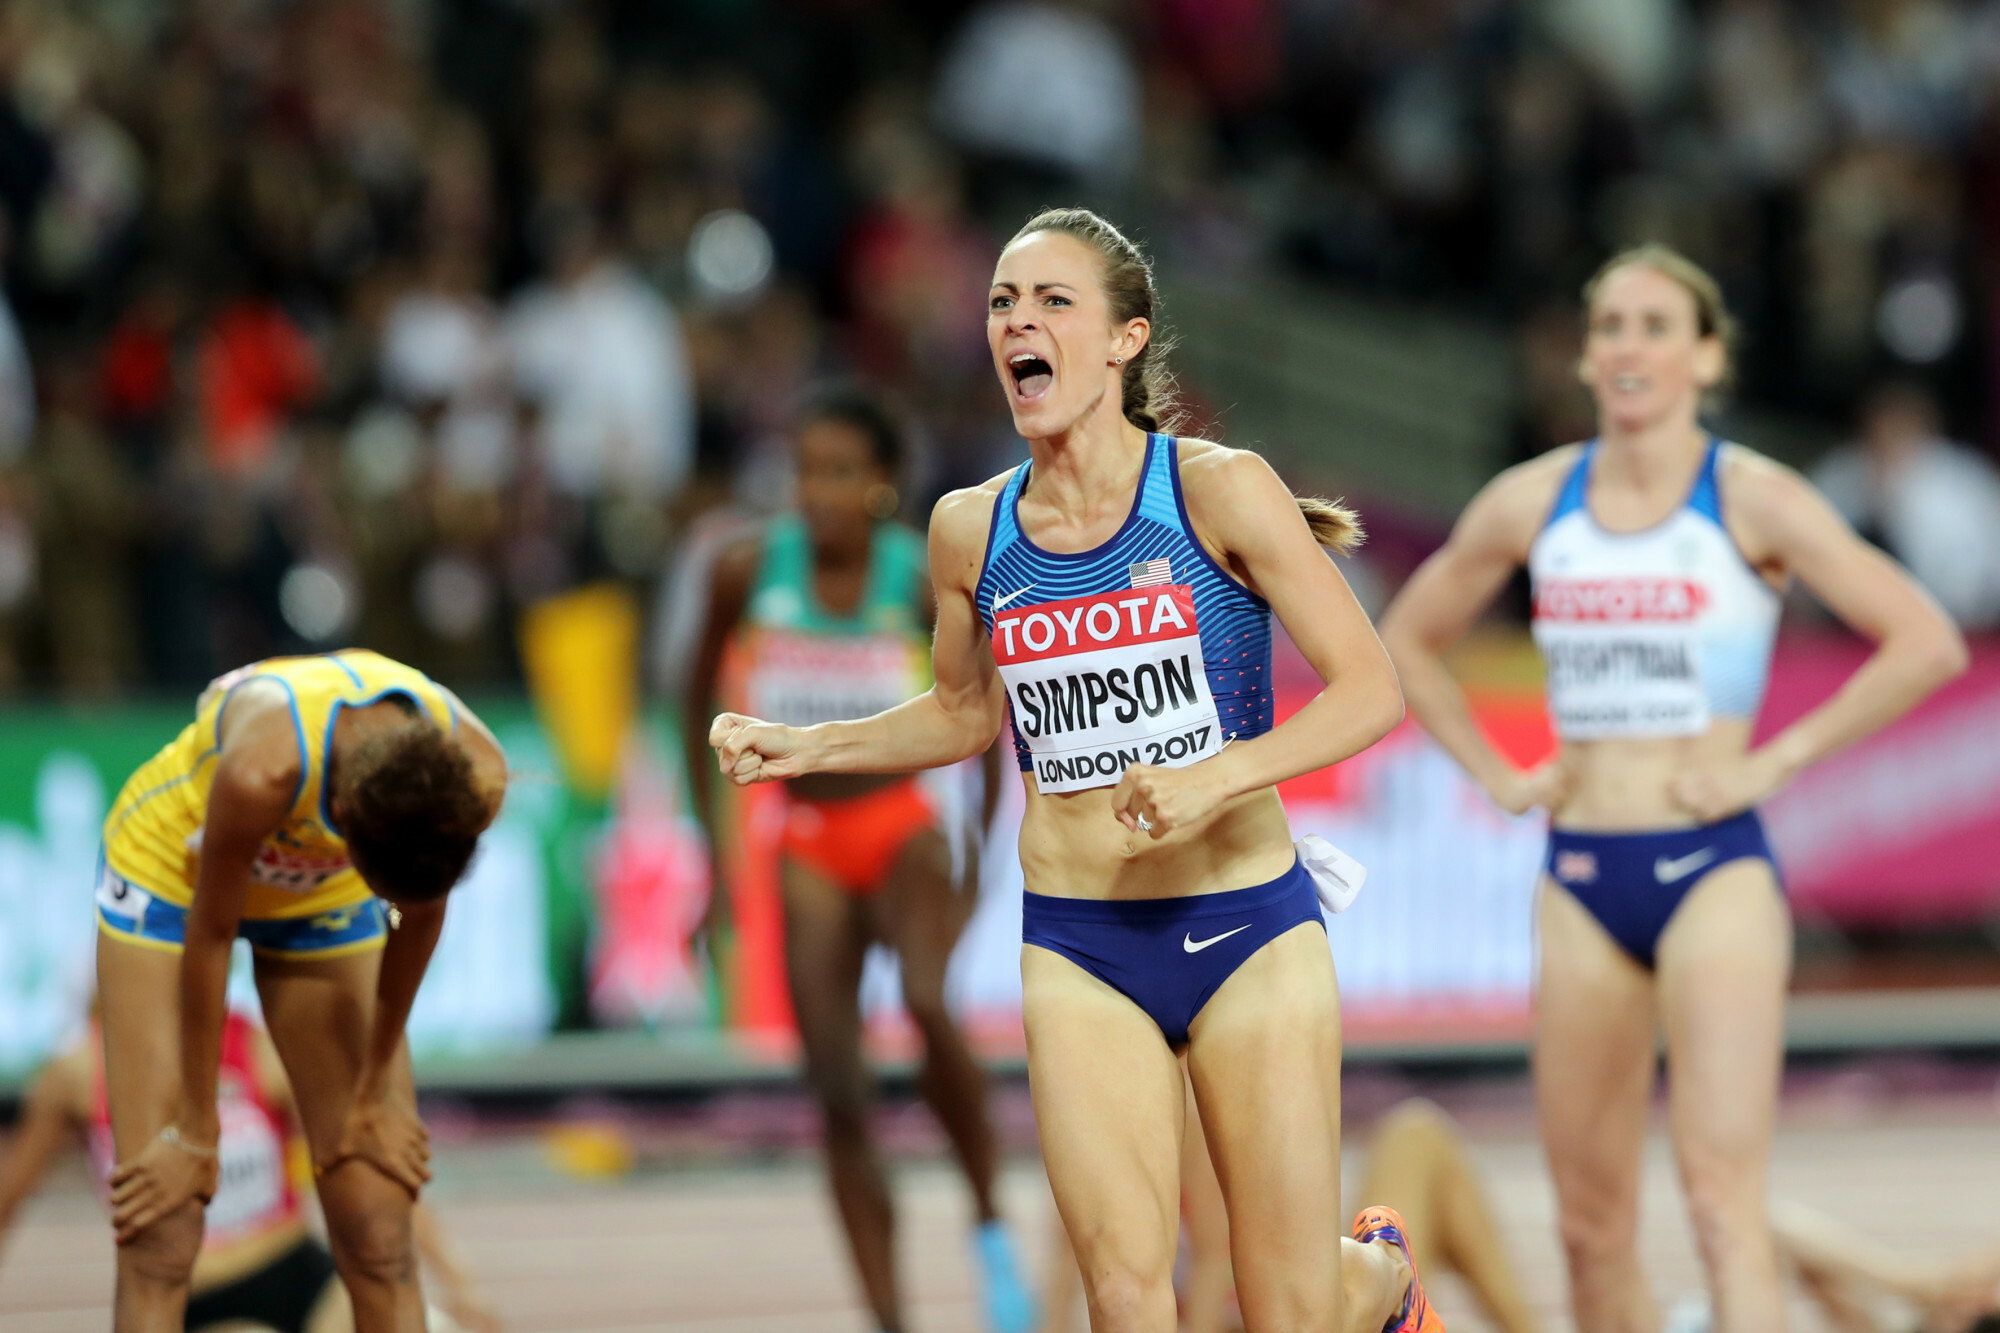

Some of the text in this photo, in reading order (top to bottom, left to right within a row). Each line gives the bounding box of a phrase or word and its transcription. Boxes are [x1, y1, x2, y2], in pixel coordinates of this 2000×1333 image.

[997, 593, 1188, 657] TOYOTA
[1016, 654, 1199, 738] SIMPSON
[1037, 725, 1212, 784] LONDON 2017
